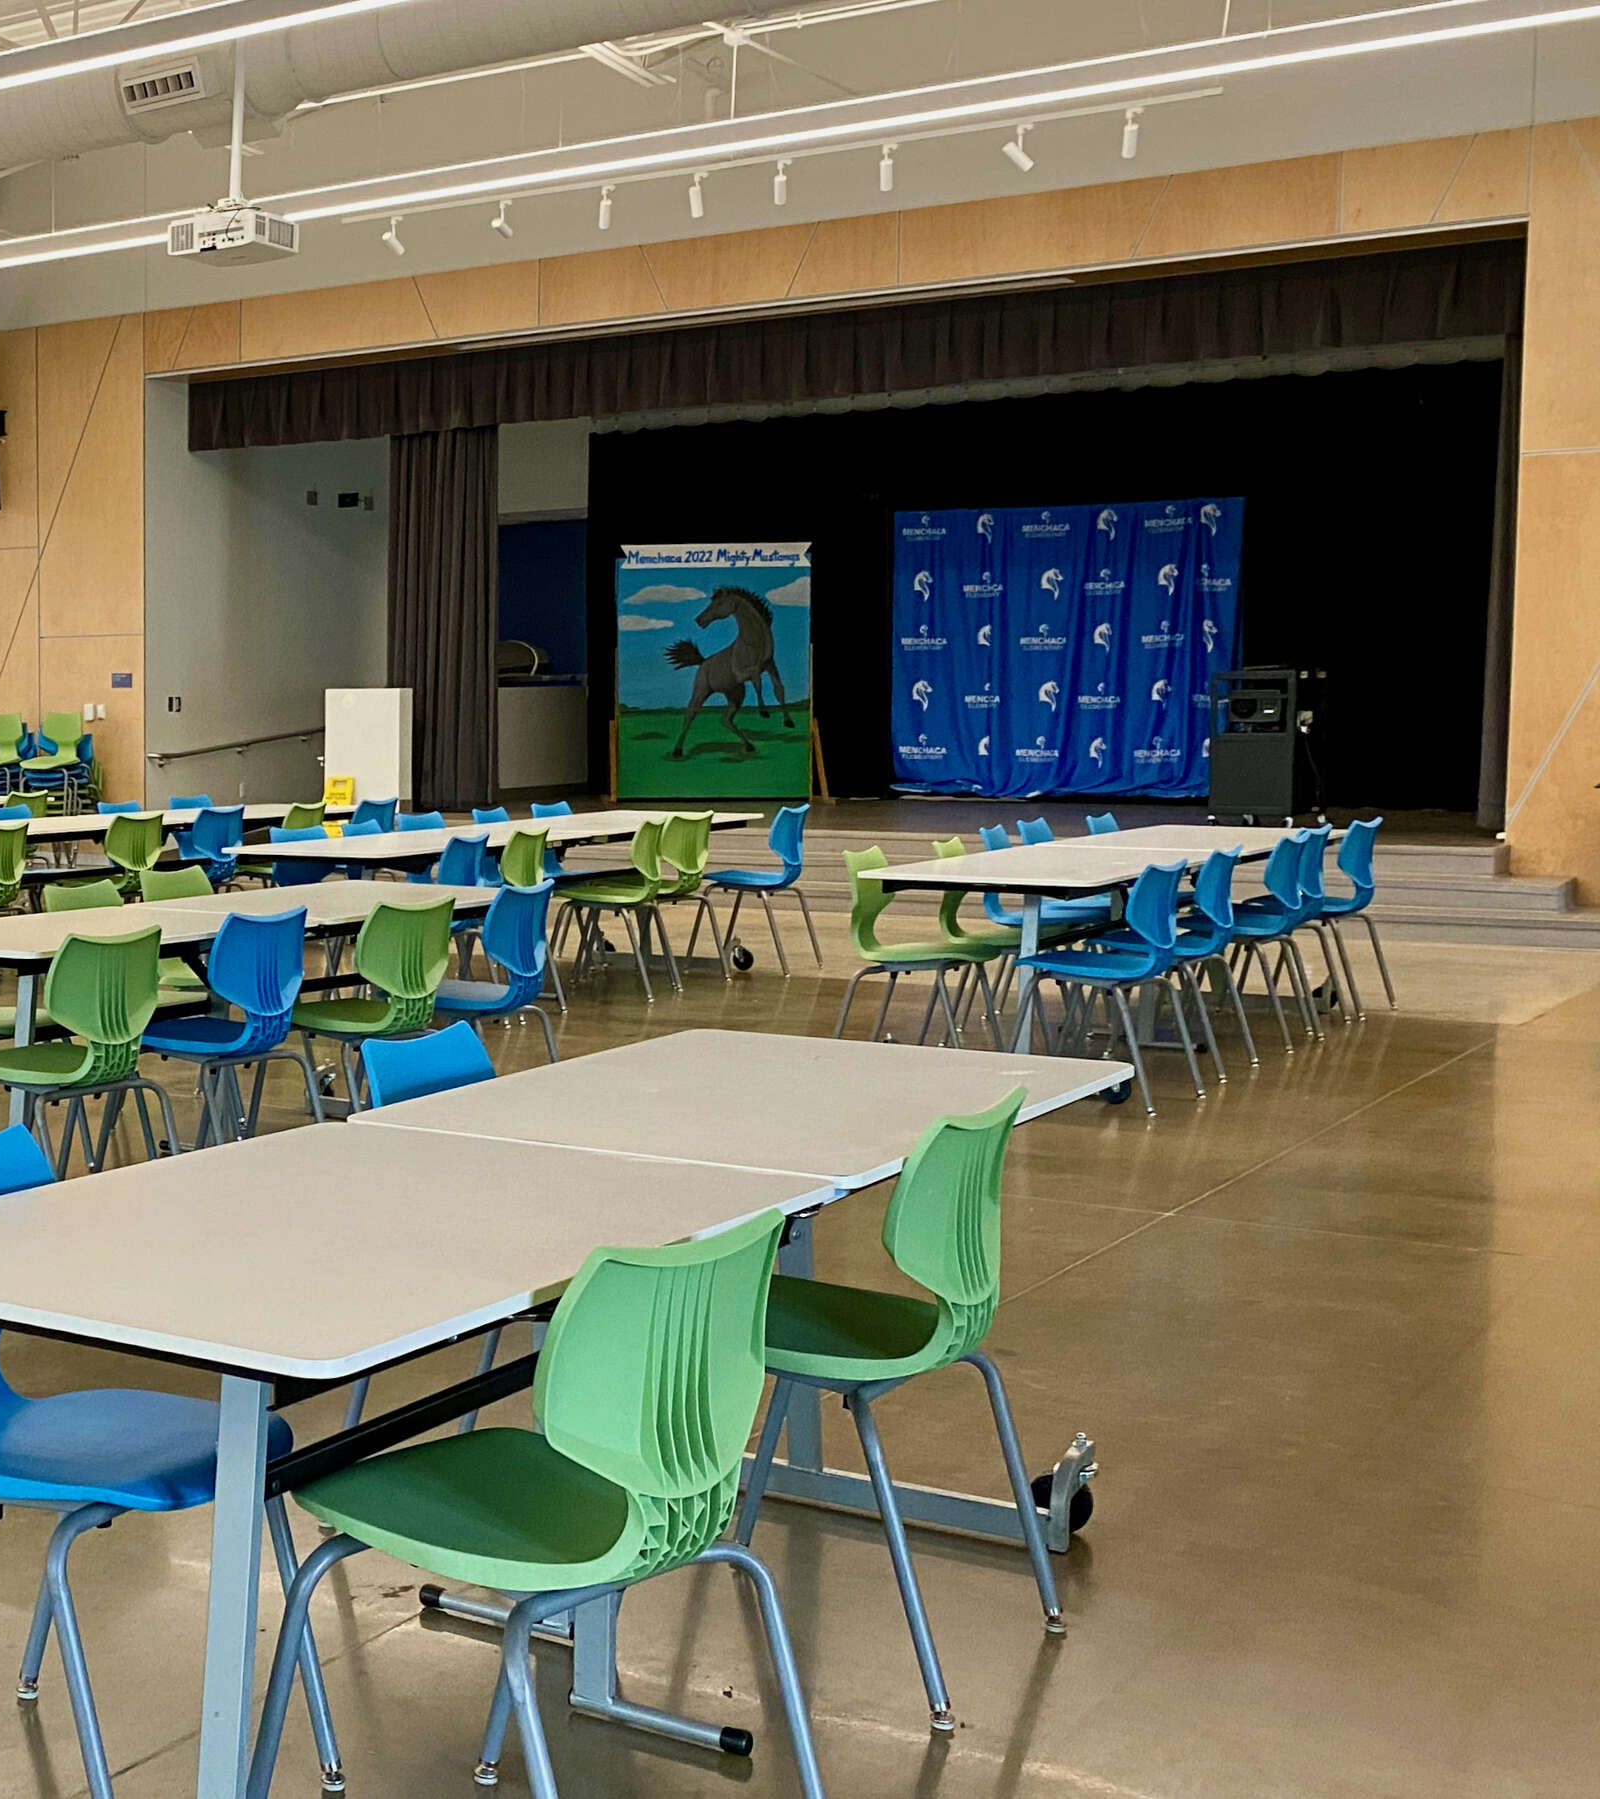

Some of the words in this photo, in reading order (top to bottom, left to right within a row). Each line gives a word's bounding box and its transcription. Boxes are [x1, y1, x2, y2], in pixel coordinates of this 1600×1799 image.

[684, 551, 713, 563] 2022
[716, 549, 750, 566] Mighty
[752, 548, 800, 566] Mustangs
